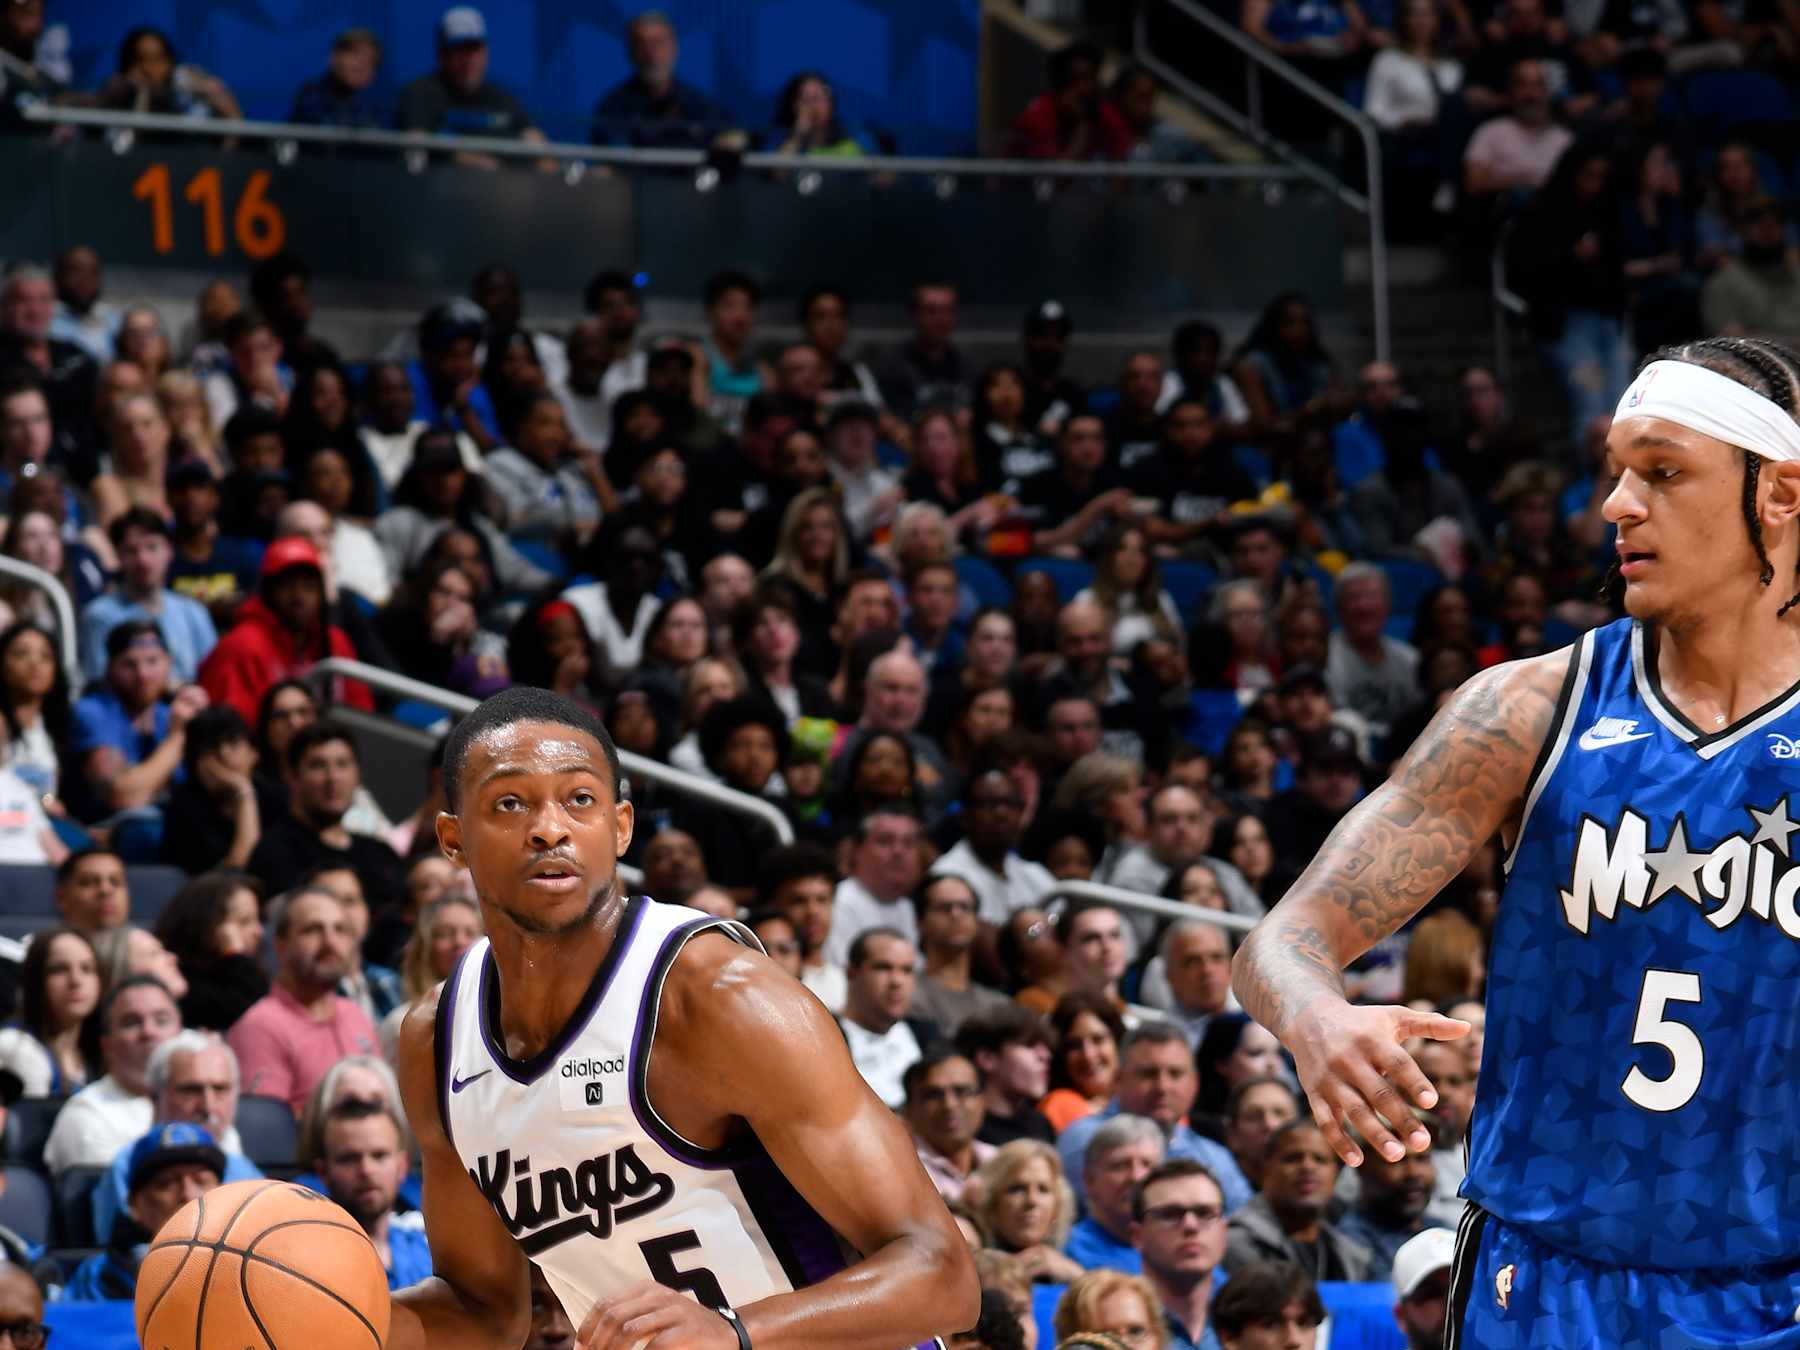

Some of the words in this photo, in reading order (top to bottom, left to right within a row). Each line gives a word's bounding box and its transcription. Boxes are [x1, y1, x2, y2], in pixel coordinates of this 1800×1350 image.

[133, 163, 285, 259] 116
[561, 1055, 625, 1080] dialpad
[1620, 968, 1704, 1113] 5
[469, 1142, 676, 1258] Kings
